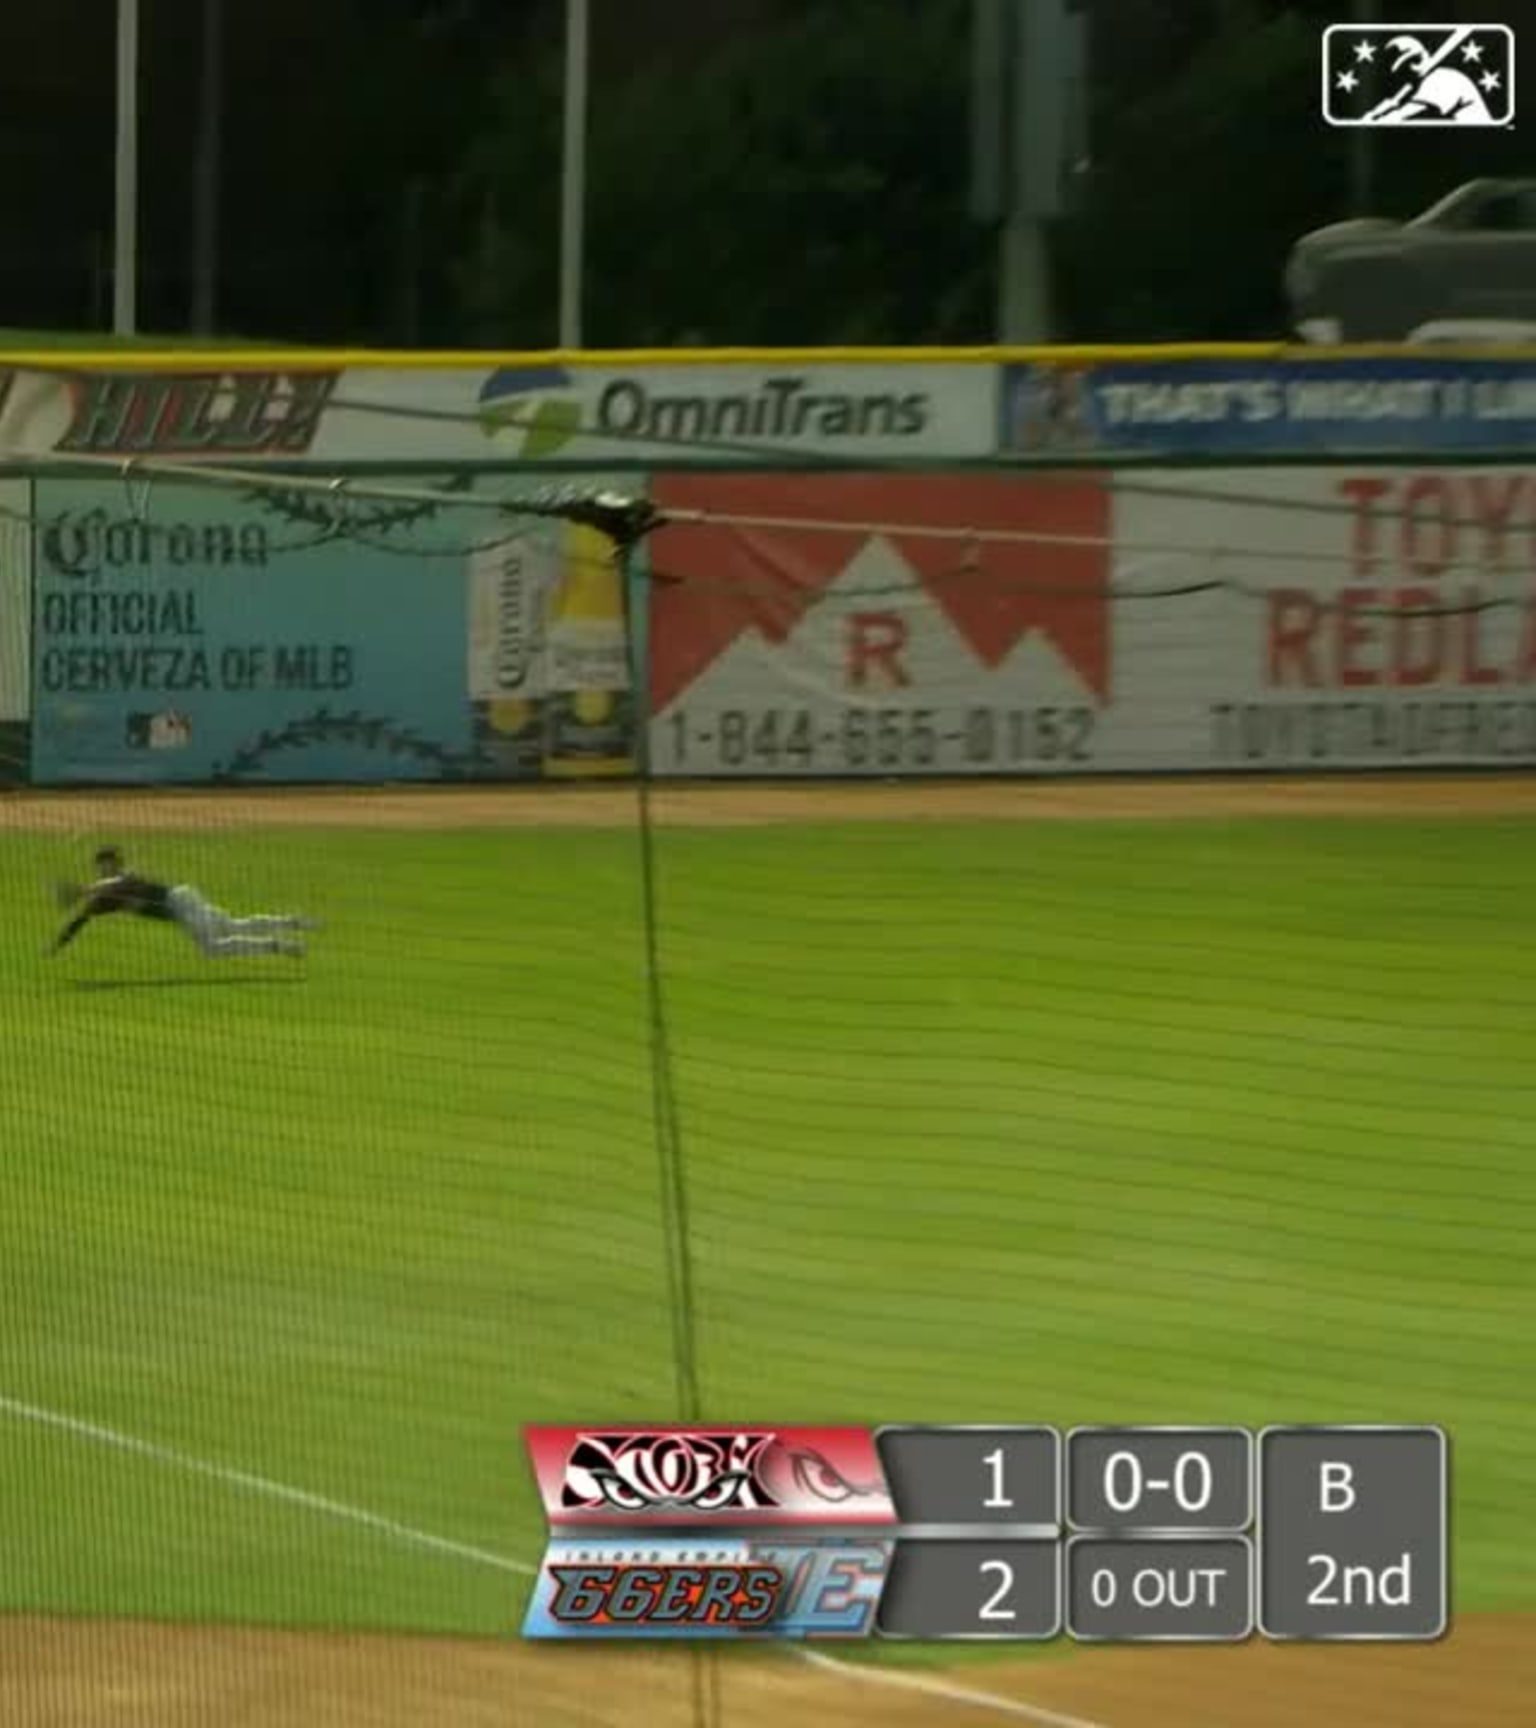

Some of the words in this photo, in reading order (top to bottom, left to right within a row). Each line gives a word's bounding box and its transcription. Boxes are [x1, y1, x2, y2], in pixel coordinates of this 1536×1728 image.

[597, 378, 928, 440] OmniTrans
[42, 508, 268, 580] Corona
[43, 592, 204, 635] OFFICIAL
[43, 648, 209, 692] CERVEZA
[221, 648, 264, 690] OF
[275, 645, 352, 690] MLB
[845, 614, 911, 687] R
